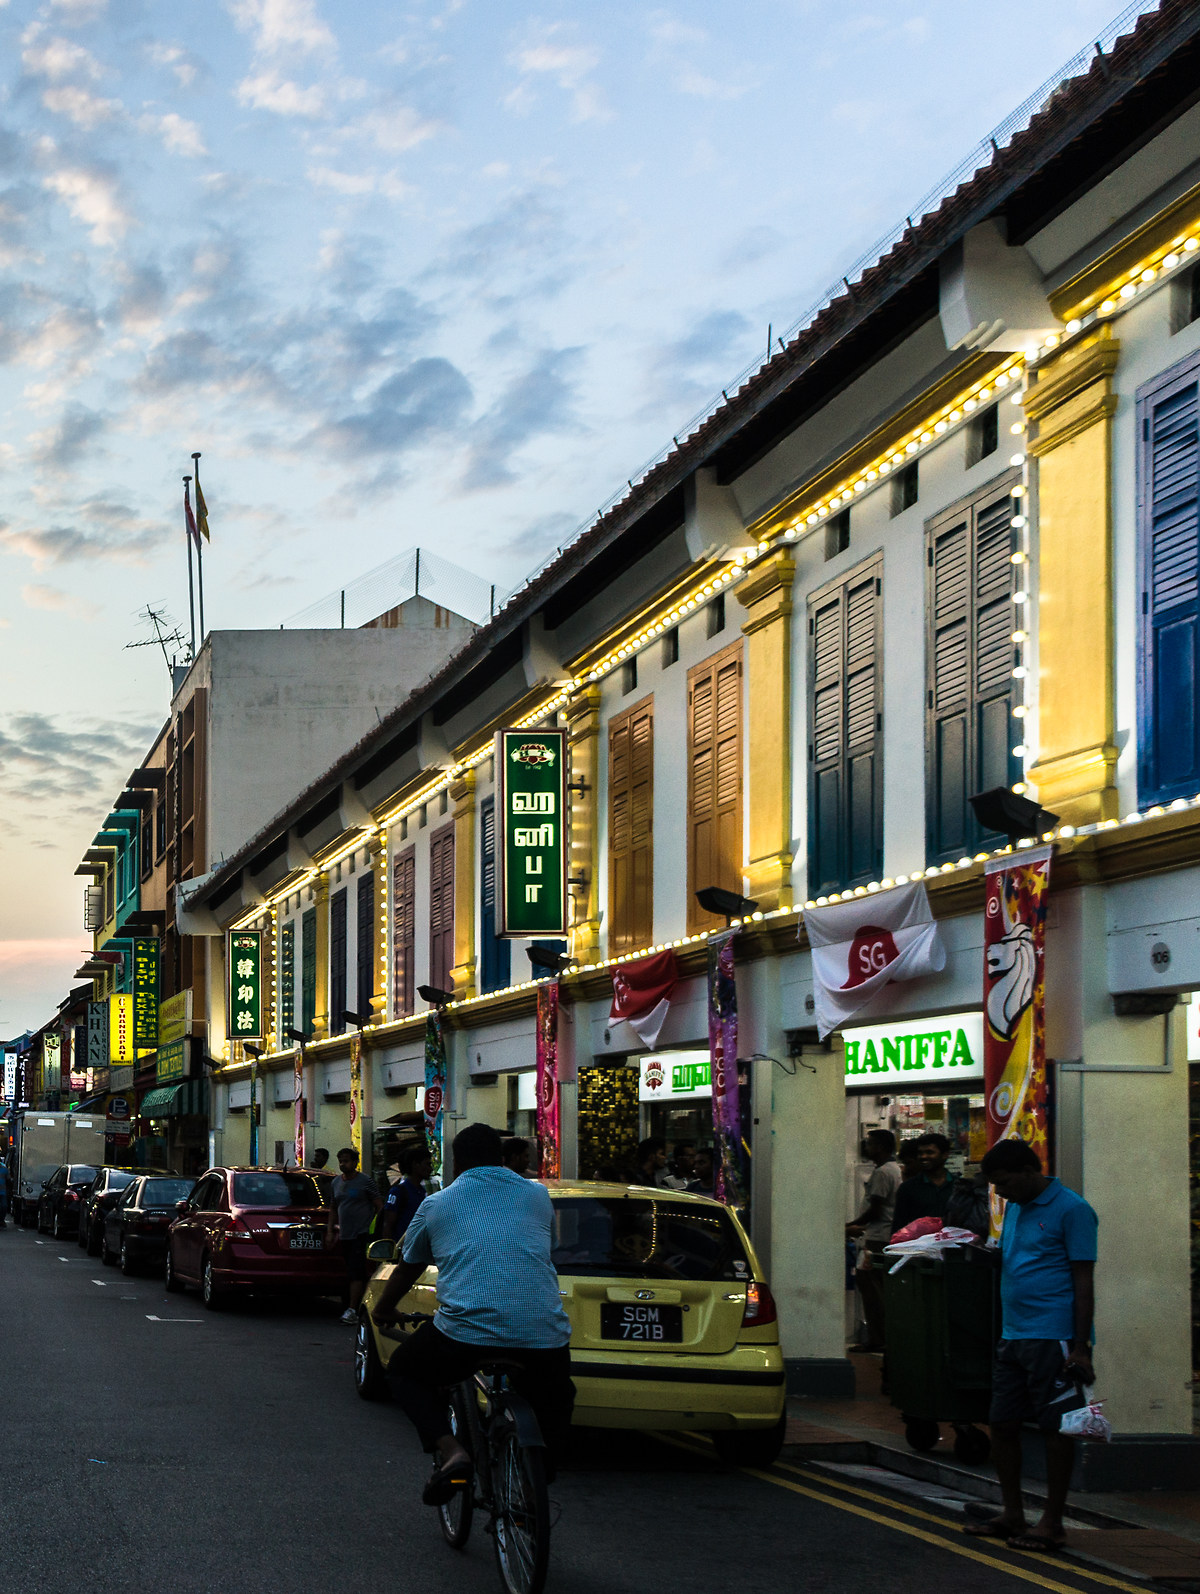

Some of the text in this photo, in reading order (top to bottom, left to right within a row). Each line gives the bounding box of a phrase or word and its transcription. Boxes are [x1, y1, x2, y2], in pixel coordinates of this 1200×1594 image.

[136, 940, 147, 950] AL
[859, 942, 886, 974] SG
[1151, 951, 1169, 964] 106
[136, 958, 148, 985] BISMI
[236, 958, 254, 1030] 韓印法
[136, 992, 148, 1038] TEXTILES
[90, 1003, 100, 1060] KHAN
[844, 1028, 975, 1075] HANIFFA
[290, 1240, 321, 1248] 8379R
[296, 1232, 315, 1240] SGY
[623, 1306, 659, 1322] SGM
[620, 1323, 664, 1340] 721B
